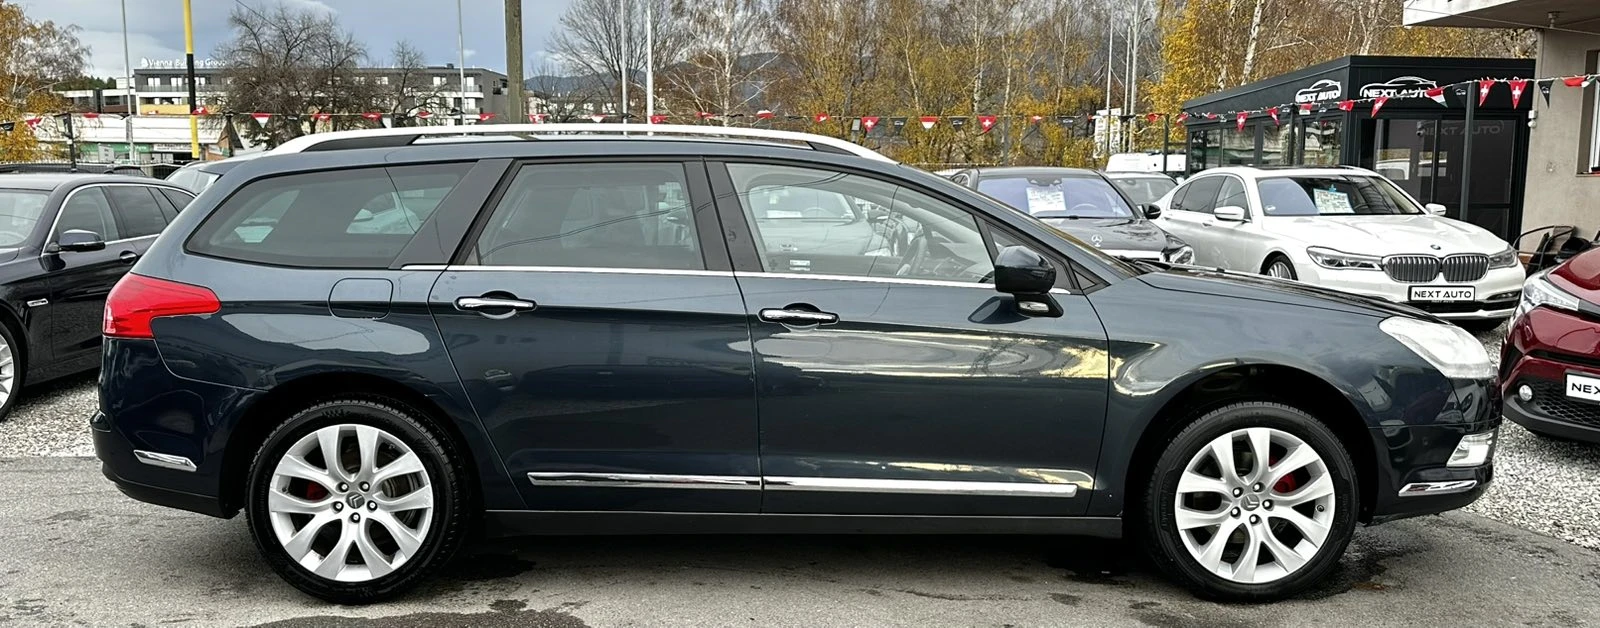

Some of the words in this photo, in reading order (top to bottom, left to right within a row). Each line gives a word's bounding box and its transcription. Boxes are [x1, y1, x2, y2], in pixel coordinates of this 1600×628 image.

[149, 57, 173, 67] Vienna
[175, 57, 204, 68] Buing
[1317, 89, 1341, 101] AUTO
[1363, 88, 1397, 98] NEXT
[1414, 290, 1441, 298] NEXT
[1443, 290, 1472, 299] AUTO
